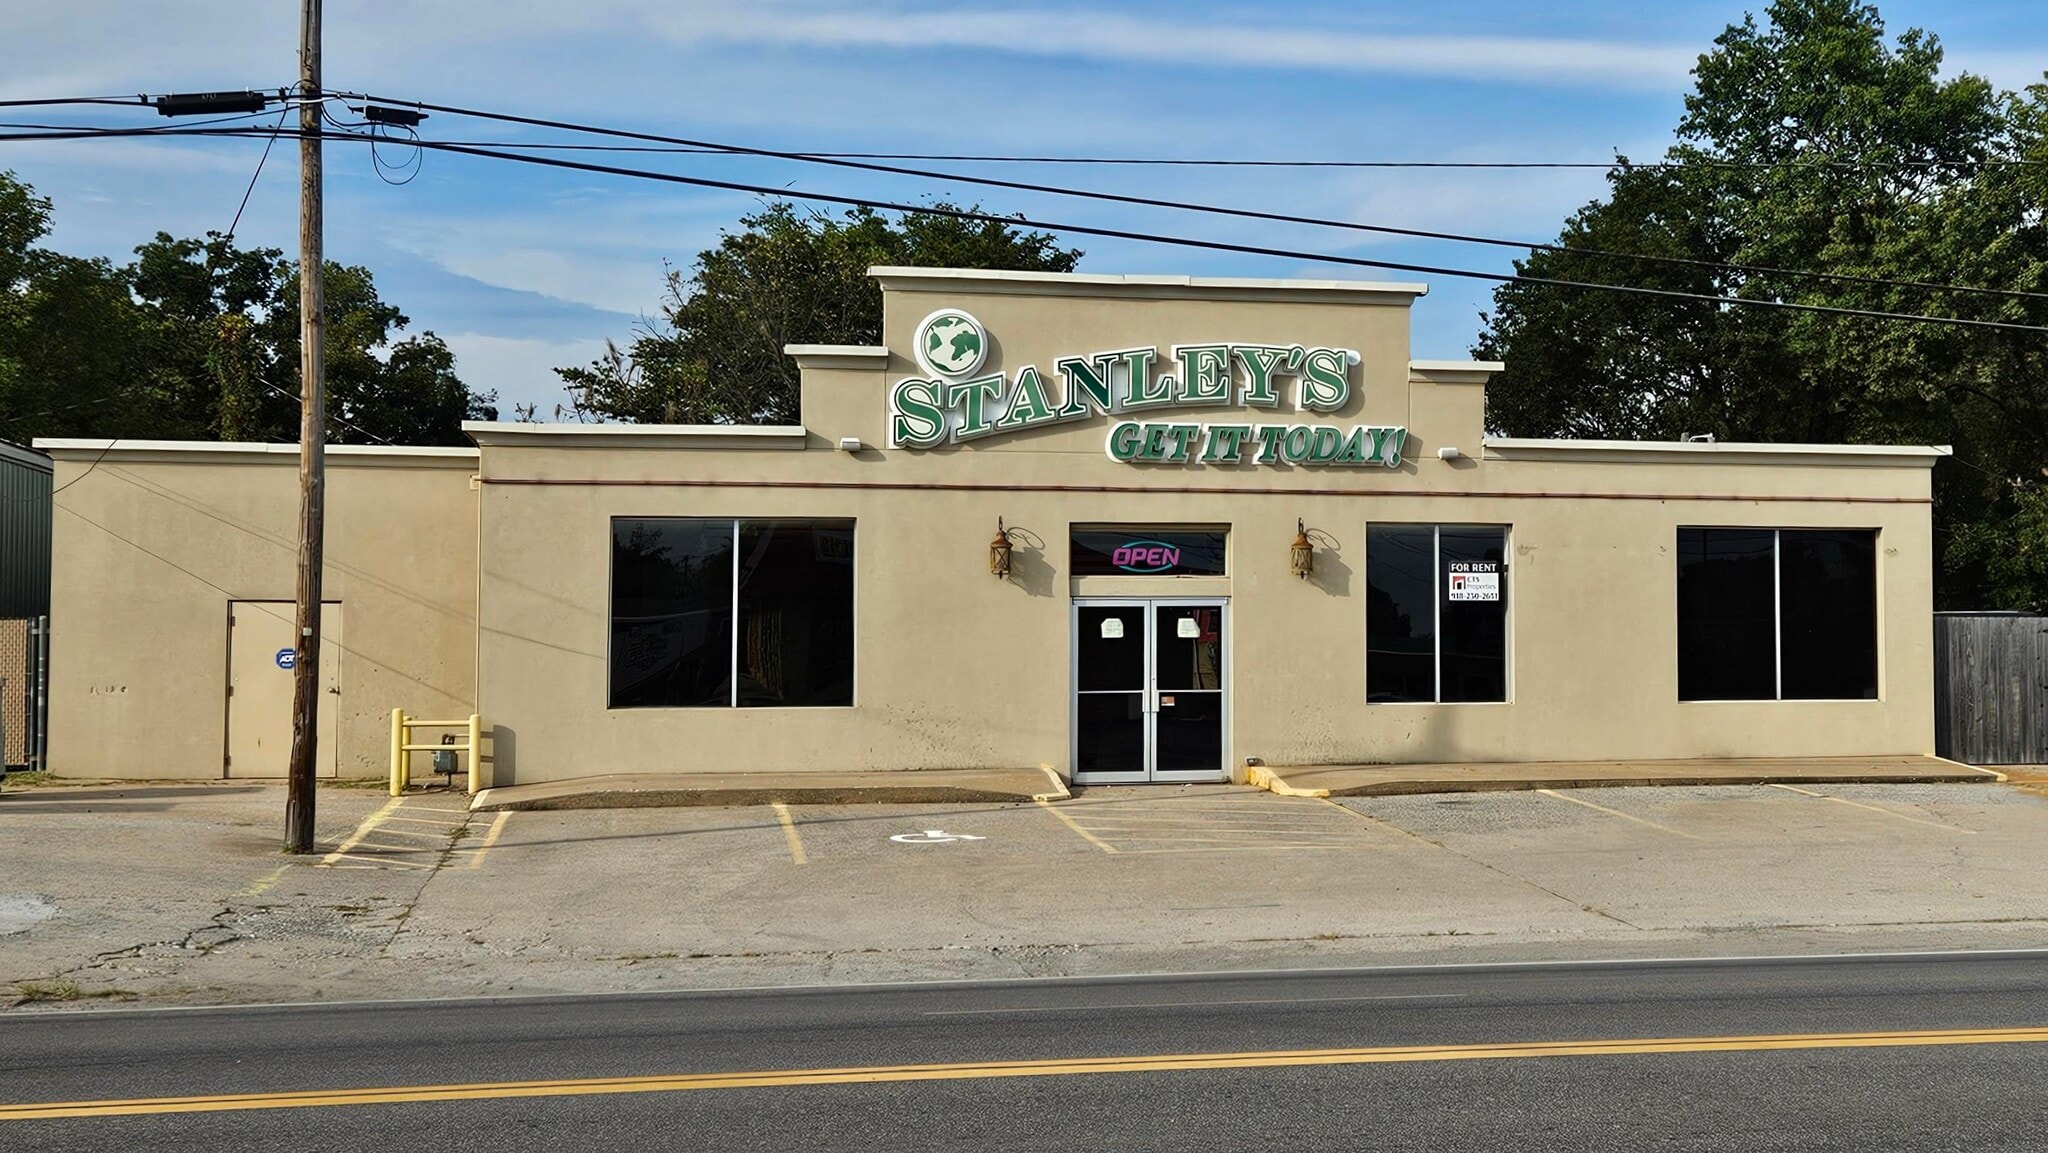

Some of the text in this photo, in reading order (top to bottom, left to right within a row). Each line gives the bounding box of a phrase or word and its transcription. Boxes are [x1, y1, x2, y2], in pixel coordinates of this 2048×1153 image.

[893, 345, 1350, 447] STANLEY'S
[1109, 423, 1407, 468] GET IT TODAY!
[1112, 548, 1180, 566] OPEN
[1451, 563, 1497, 572] FOR RENT
